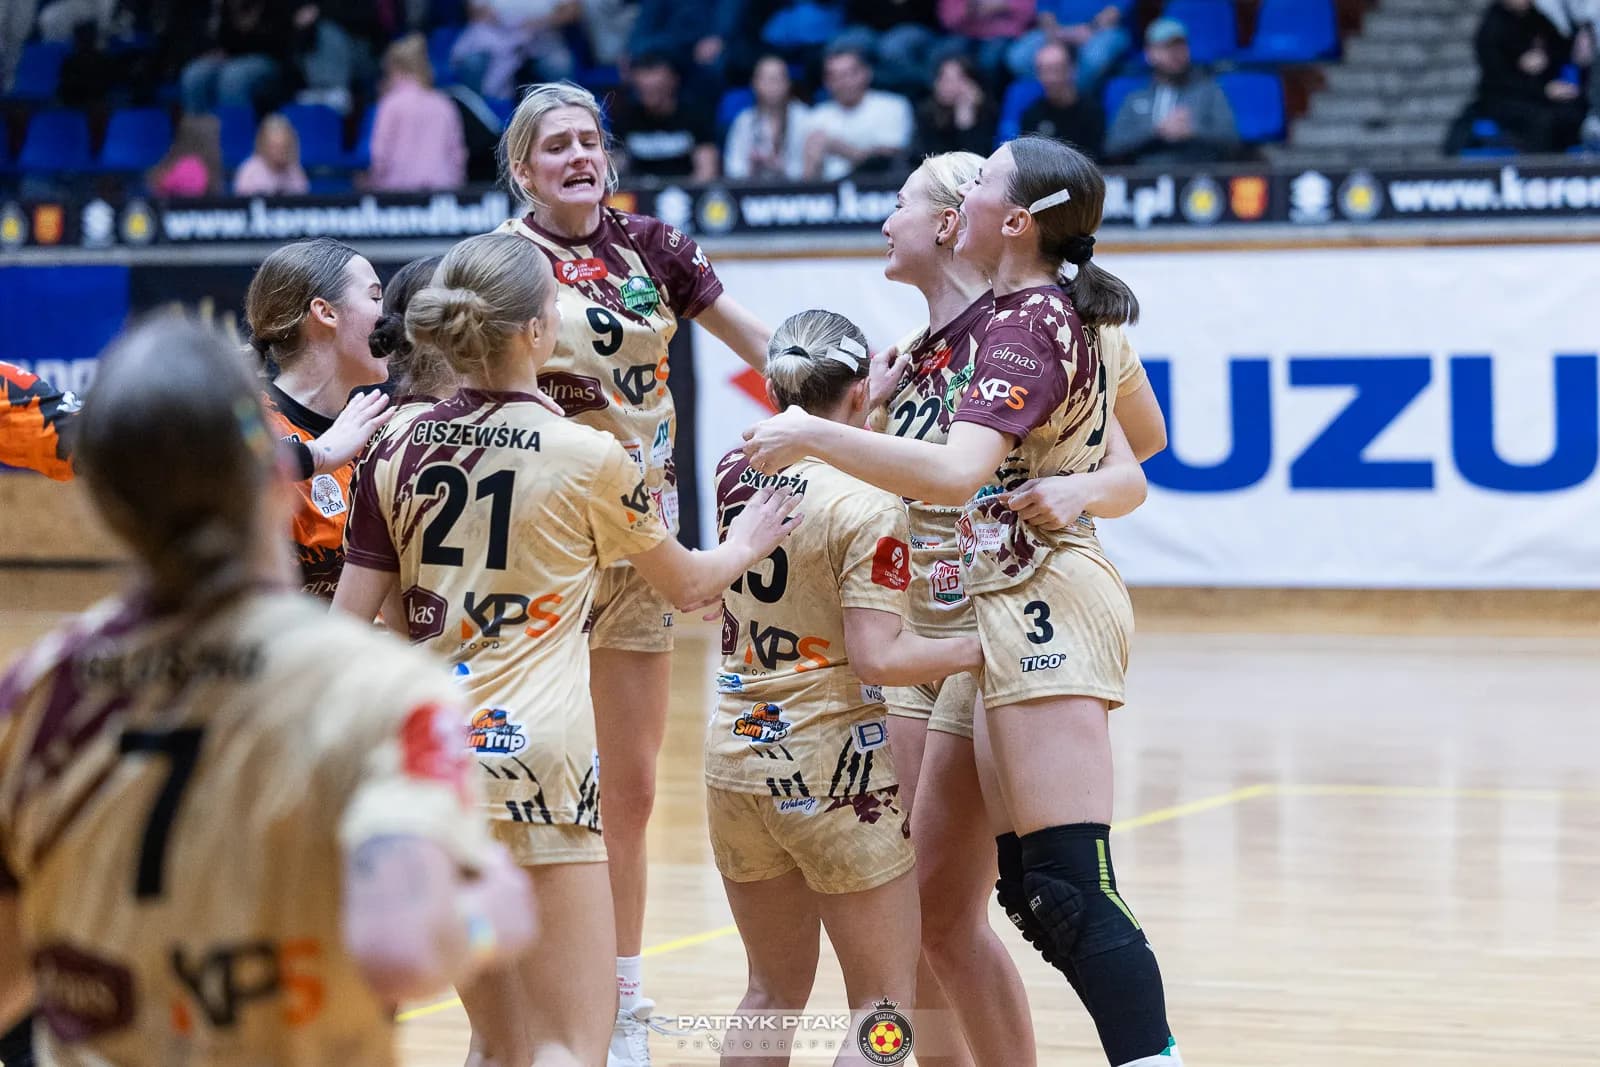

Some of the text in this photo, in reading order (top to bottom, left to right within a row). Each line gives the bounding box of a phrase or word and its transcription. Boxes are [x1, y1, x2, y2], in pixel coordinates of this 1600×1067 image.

[585, 307, 624, 356] 9
[992, 346, 1039, 371] elmas
[539, 379, 597, 401] elmas
[972, 377, 1030, 410] KPS
[412, 421, 542, 453] CISZEWŚKA
[894, 395, 942, 440] 22
[322, 502, 344, 515] DCM
[415, 464, 516, 571] 21
[461, 591, 563, 639] KPS
[1023, 600, 1054, 645] 3
[461, 641, 500, 650] FOOD
[745, 620, 831, 673] KPS
[465, 731, 526, 753] unTrip
[119, 723, 206, 899] 7
